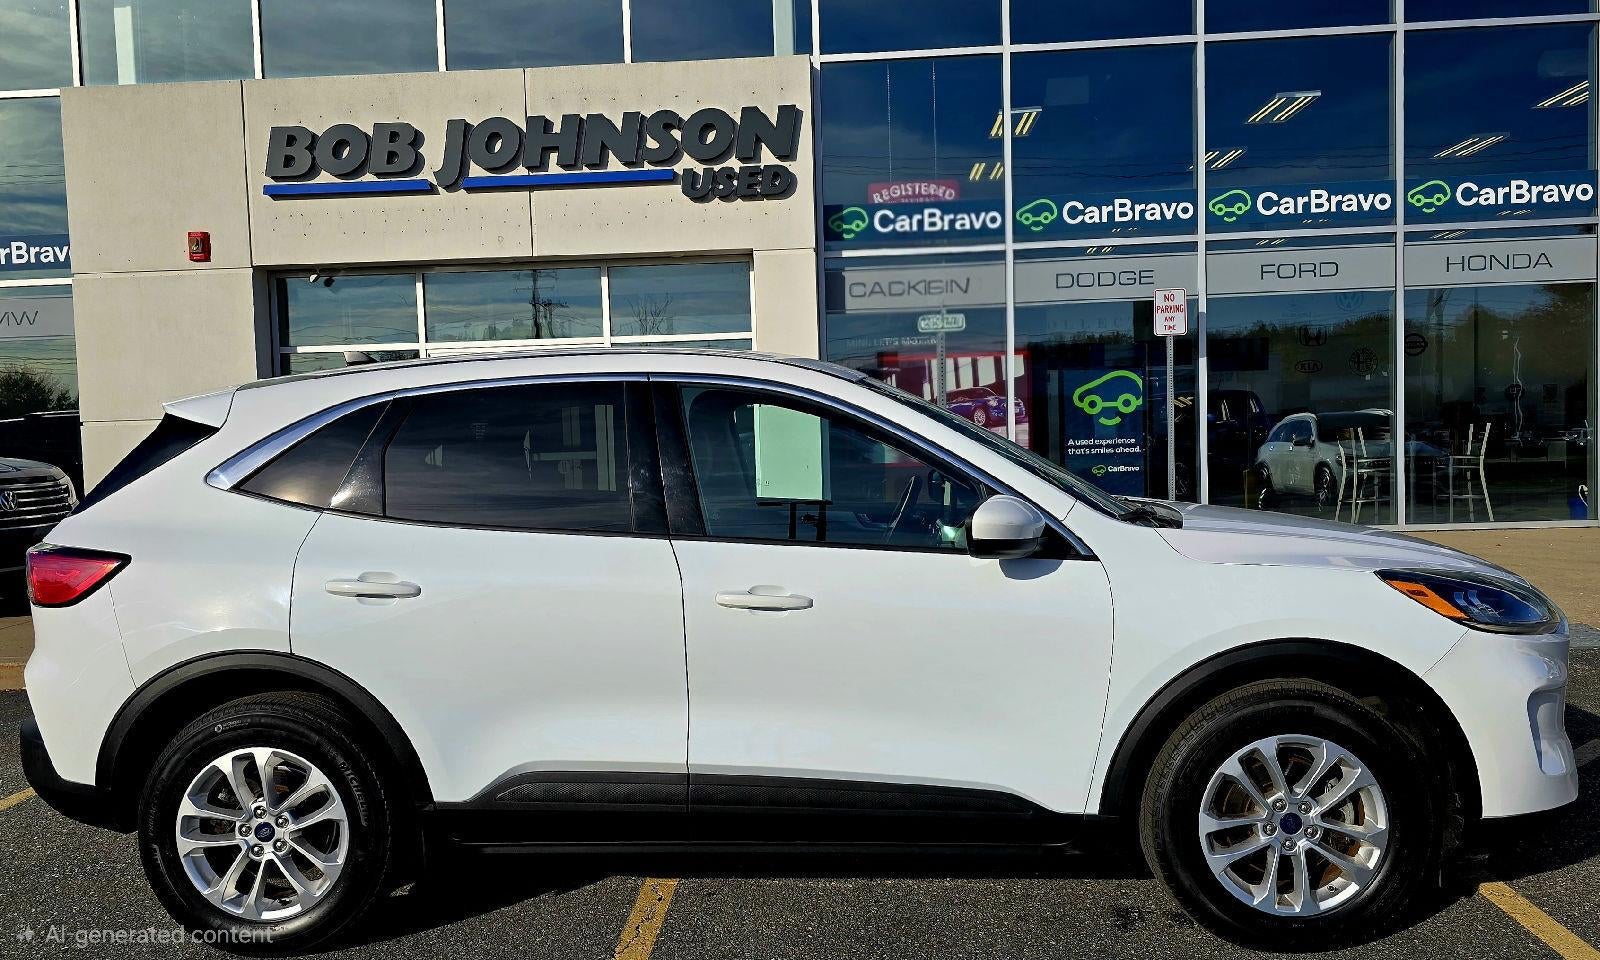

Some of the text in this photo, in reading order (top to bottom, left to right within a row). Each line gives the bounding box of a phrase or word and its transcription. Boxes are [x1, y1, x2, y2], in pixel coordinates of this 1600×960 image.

[265, 104, 803, 192] BOB JOHNSON
[681, 164, 798, 202] USED
[1455, 179, 1594, 207] CarBravo
[1062, 198, 1194, 225] CarBravo
[1256, 189, 1393, 216] CarBravo
[873, 207, 1002, 233] CarBravo
[0, 241, 71, 265] rBrav
[1446, 252, 1553, 272] HONDA
[1056, 269, 1155, 289] DODGE
[1260, 261, 1340, 280] FORD
[1156, 303, 1184, 314] PARKING
[1163, 293, 1175, 303] NO
[1067, 437, 1136, 446] A used experience
[1067, 445, 1142, 455] that's smiles ahead.
